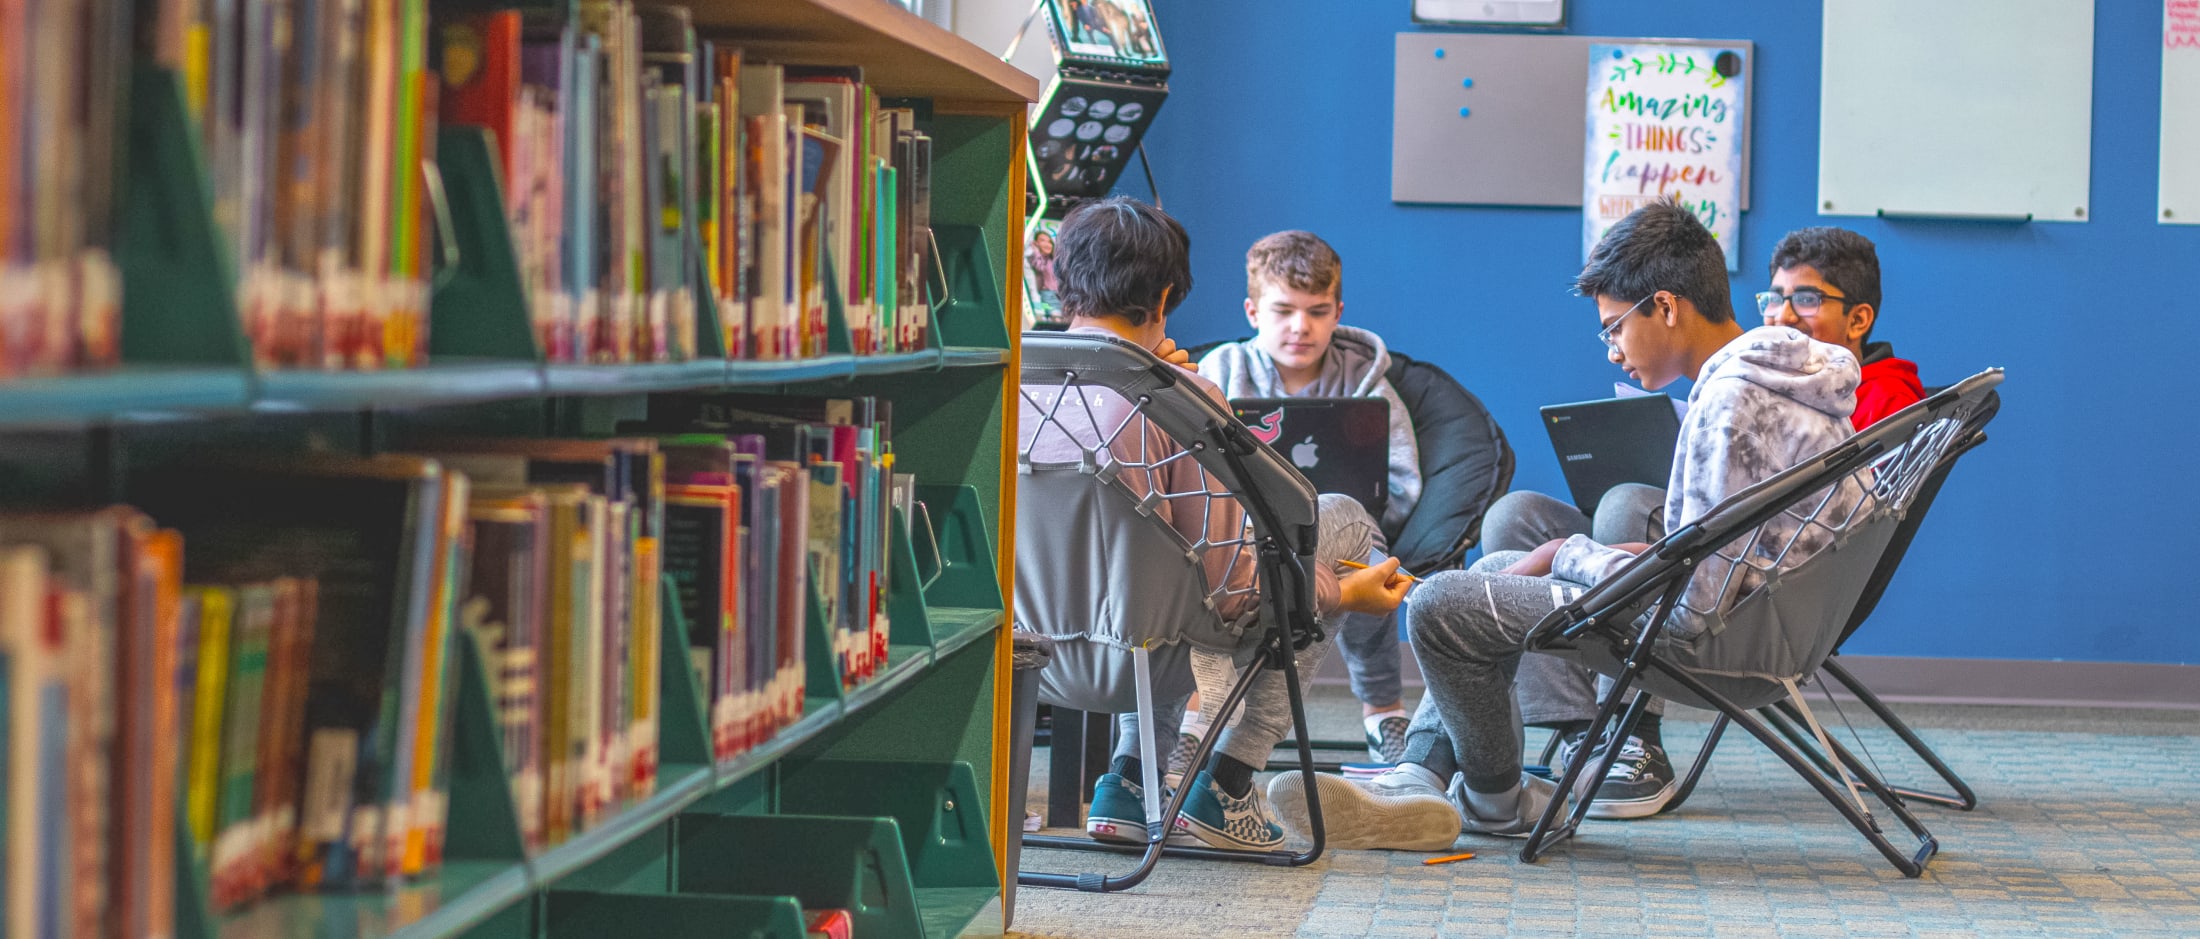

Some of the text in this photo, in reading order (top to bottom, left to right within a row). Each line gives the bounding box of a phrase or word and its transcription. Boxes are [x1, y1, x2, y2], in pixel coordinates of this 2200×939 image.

[1600, 86, 1727, 122] Amazing
[1626, 123, 1703, 154] THINGS
[1602, 150, 1722, 193] happen
[1566, 453, 1592, 461] SAMSUNG
